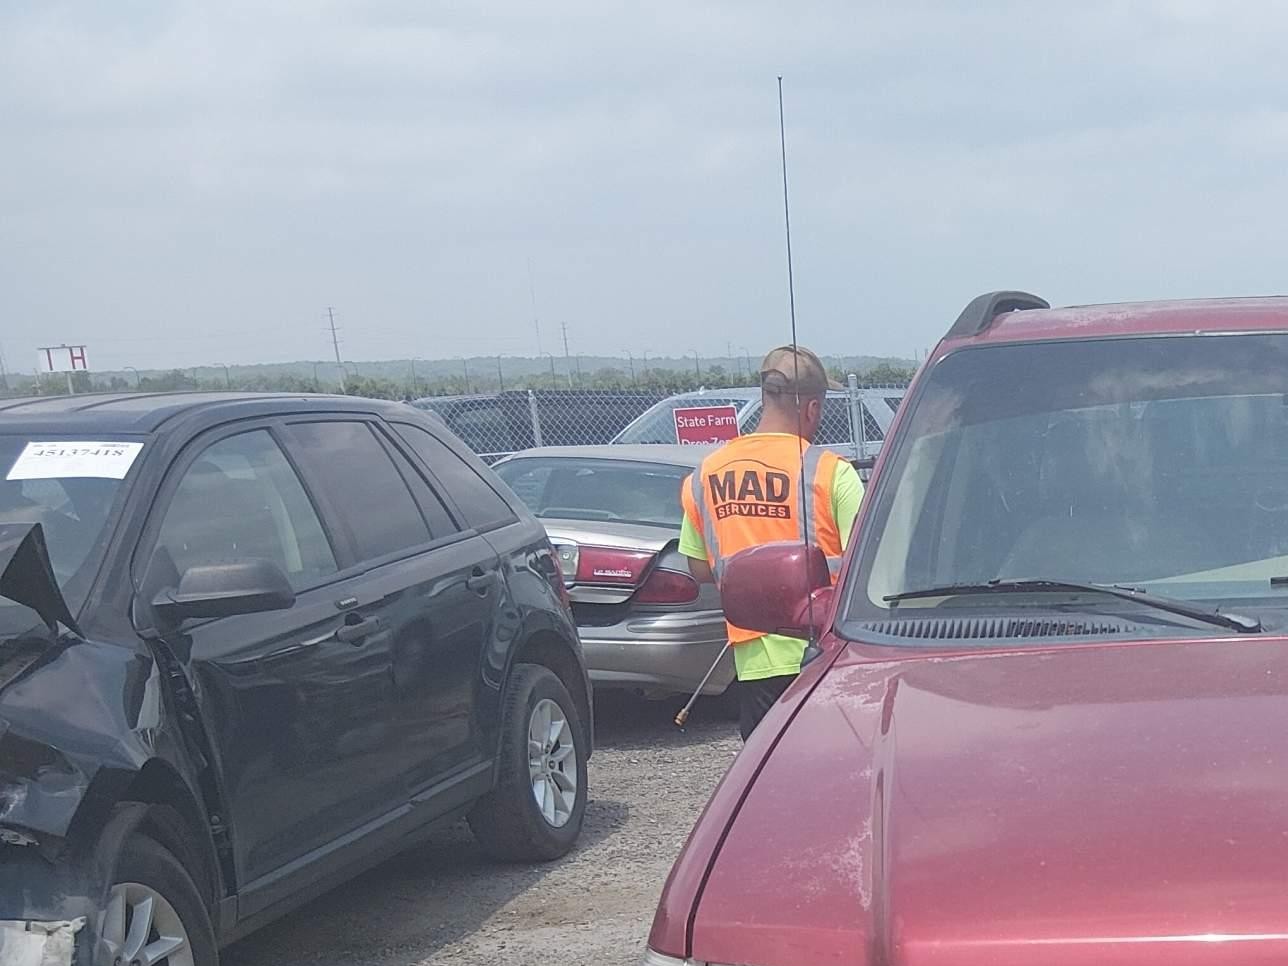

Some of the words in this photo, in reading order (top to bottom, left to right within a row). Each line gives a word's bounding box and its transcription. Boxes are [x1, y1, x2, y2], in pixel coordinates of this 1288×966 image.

[68, 346, 88, 370] H
[677, 415, 706, 428] State
[707, 414, 736, 426] Farm
[33, 449, 125, 457] 45137418
[708, 470, 790, 506] MAD
[718, 504, 786, 518] SERVICES
